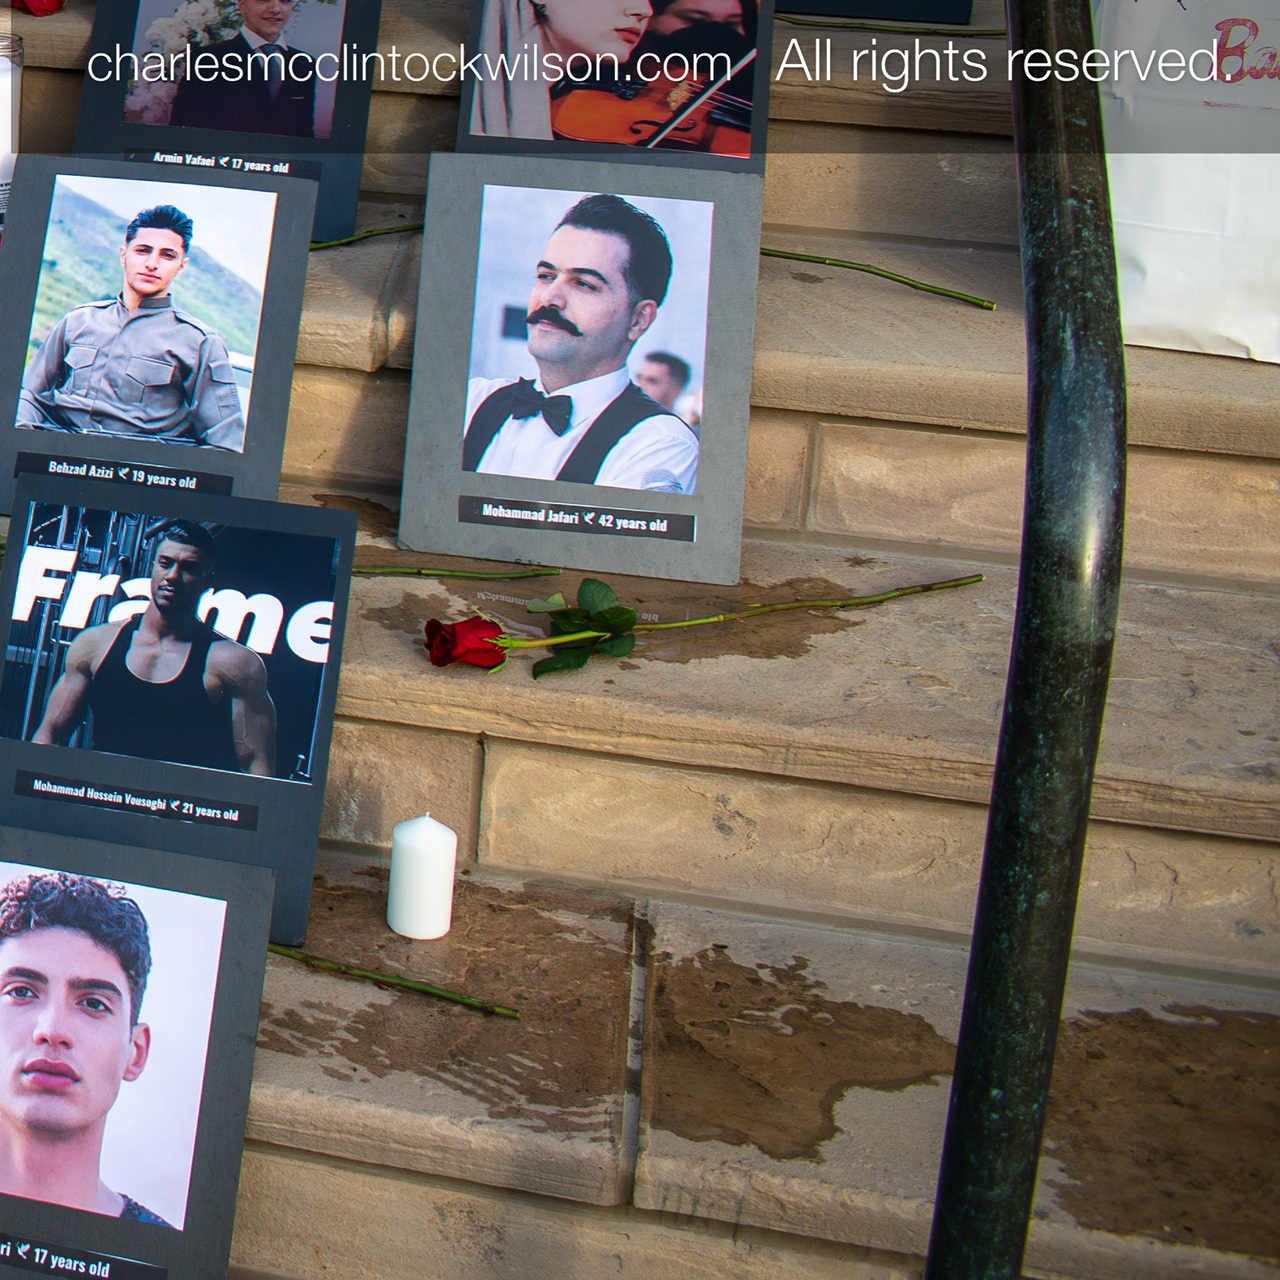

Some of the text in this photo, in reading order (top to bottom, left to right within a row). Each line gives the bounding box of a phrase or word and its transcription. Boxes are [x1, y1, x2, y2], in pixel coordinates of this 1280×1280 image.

[153, 151, 183, 164] Armin
[231, 158, 243, 169] 17
[243, 160, 271, 172] years
[272, 162, 289, 173] old
[48, 460, 197, 489] Behzad Azizi 19 years old
[482, 503, 669, 532] Mohammad Jafari 42 years old
[32, 778, 239, 822] Mohammad Hossein 21 years old
[34, 1247, 49, 1264] 17
[50, 1254, 86, 1272] years
[88, 1261, 111, 1278] old
